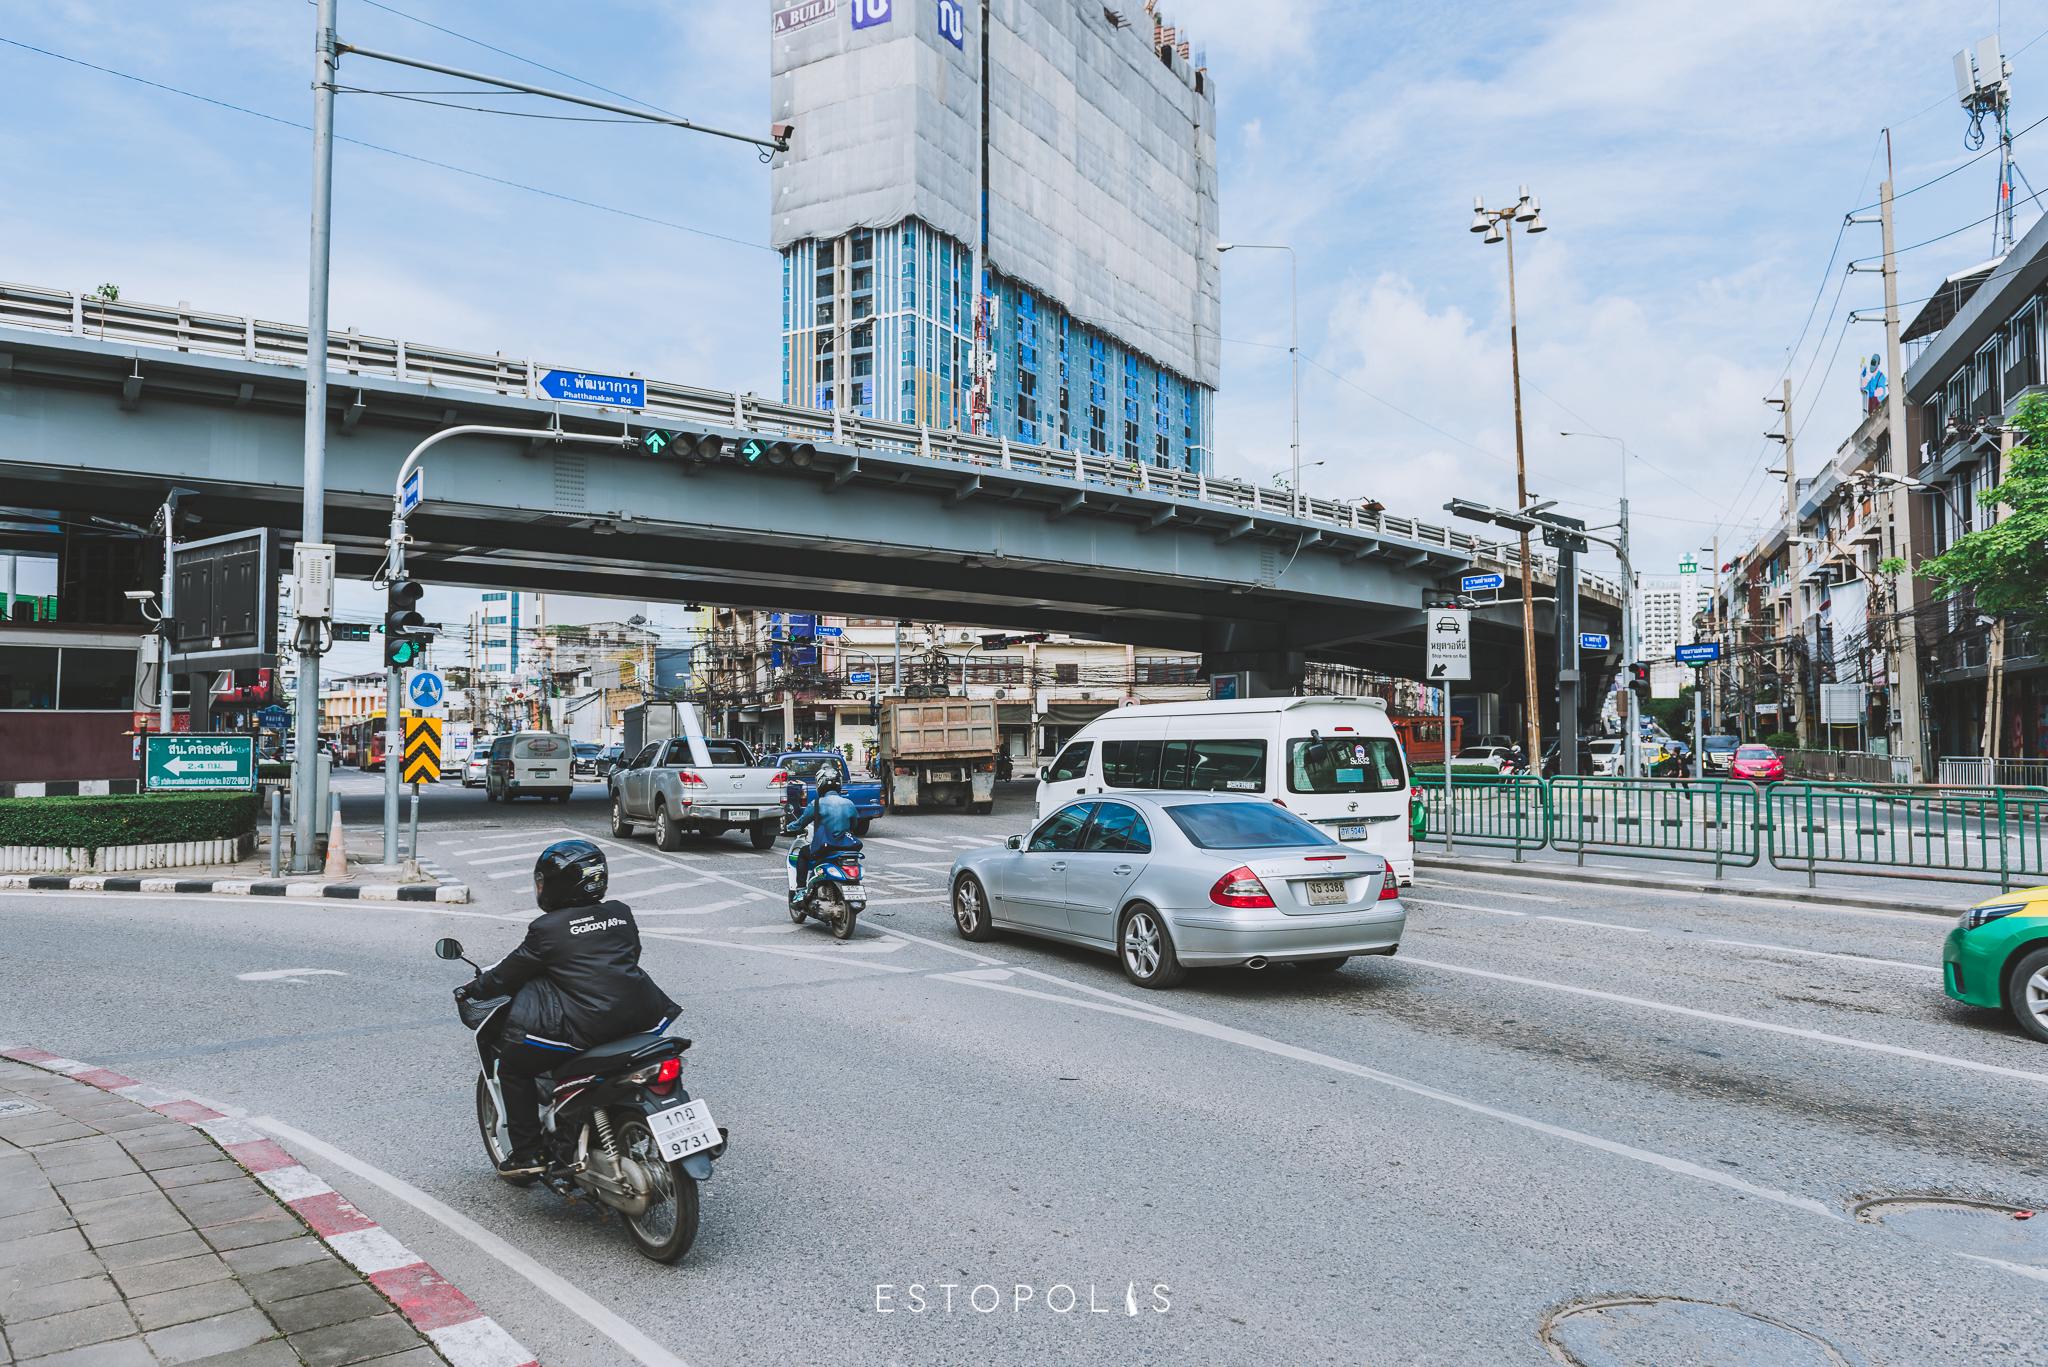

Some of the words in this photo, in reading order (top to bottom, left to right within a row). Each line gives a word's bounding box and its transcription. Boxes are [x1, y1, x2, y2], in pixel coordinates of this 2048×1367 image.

[775, 16, 786, 31] A
[574, 374, 638, 395] พัฒนาการ
[563, 390, 615, 403] Phatthanakan
[1681, 565, 1696, 573] HA
[388, 745, 393, 754] 7
[1324, 882, 1345, 893] 3388
[570, 921, 607, 934] Galaxy
[607, 917, 618, 928] A9
[671, 1133, 710, 1155] 9731
